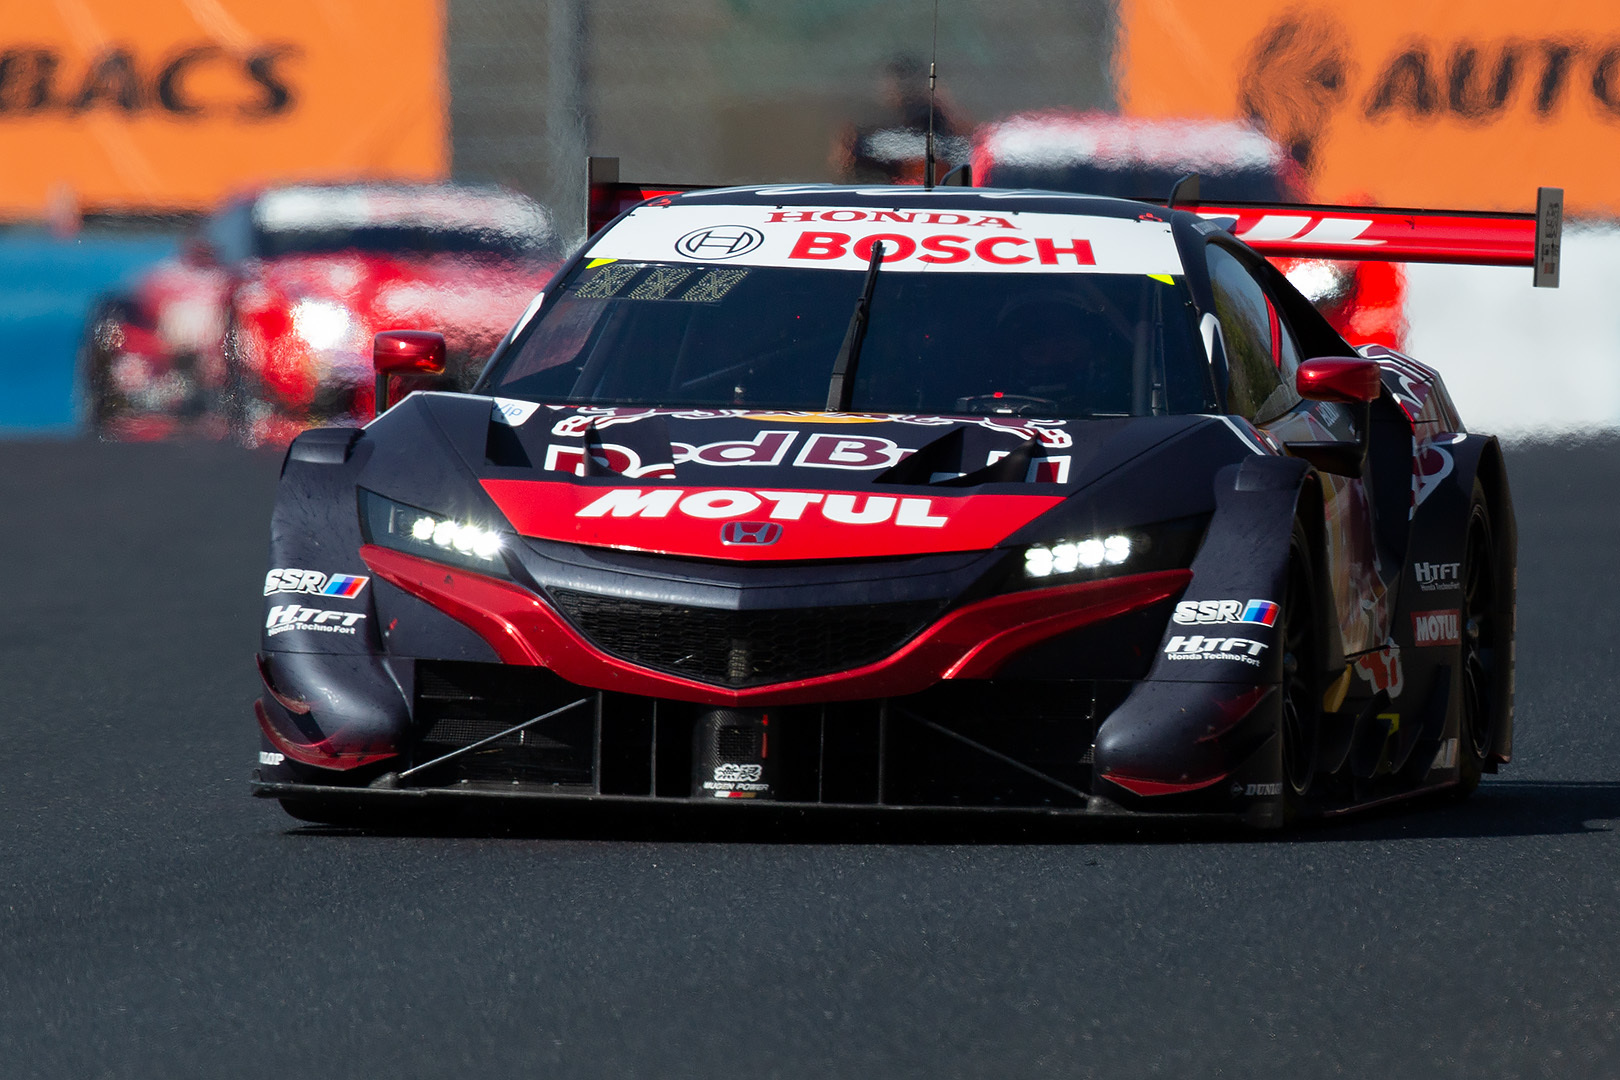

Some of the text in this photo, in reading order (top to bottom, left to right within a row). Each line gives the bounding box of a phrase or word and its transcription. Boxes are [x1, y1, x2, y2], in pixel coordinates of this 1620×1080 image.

[768, 209, 1017, 229] HONDA
[788, 231, 1097, 266] BOSCH
[575, 488, 949, 528] MOTUL
[264, 568, 327, 596] SSR
[1414, 562, 1460, 582] HTFT
[266, 604, 367, 628] HTFT
[1173, 599, 1243, 625] SSR
[1416, 614, 1459, 642] MOTUL
[1164, 635, 1269, 656] HTFT
[1168, 653, 1203, 661] Honda
[735, 782, 770, 791] POWER
